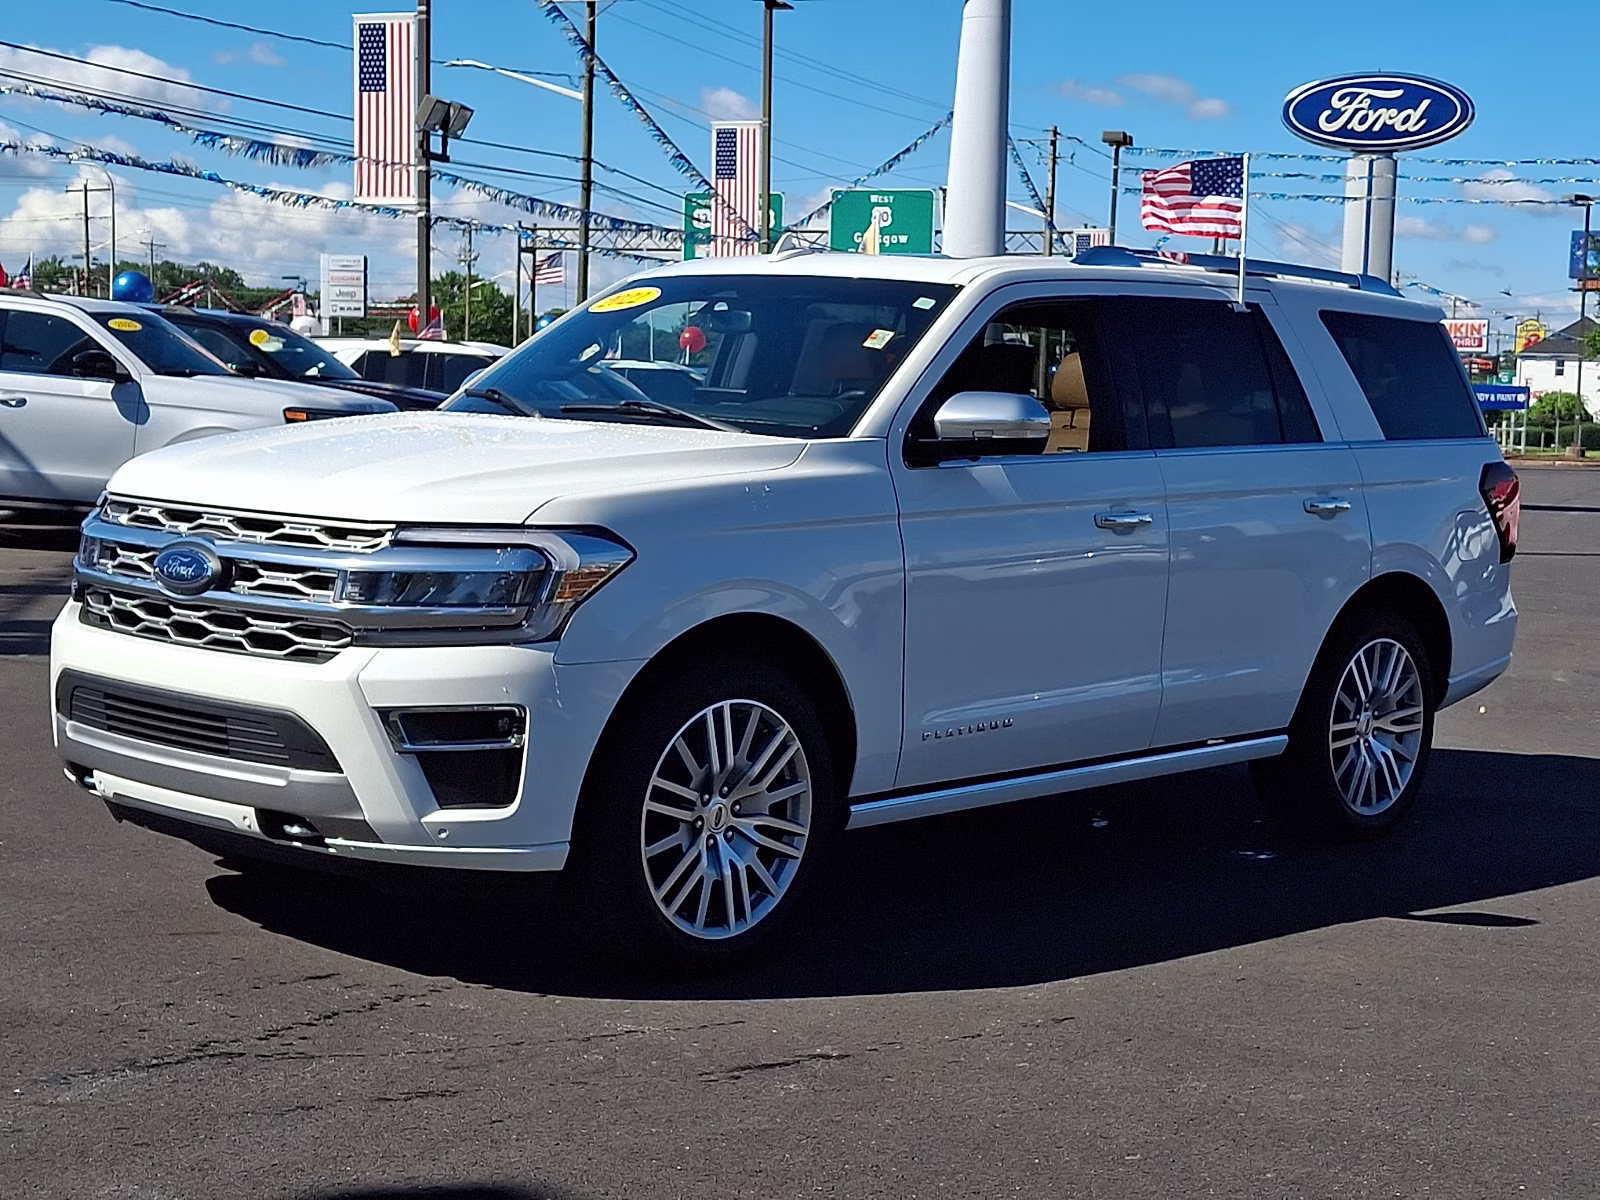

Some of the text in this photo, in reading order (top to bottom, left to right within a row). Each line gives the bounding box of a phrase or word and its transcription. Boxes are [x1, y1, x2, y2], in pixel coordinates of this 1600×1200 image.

[1318, 87, 1432, 133] Ford
[869, 194, 894, 203] WEST
[335, 288, 356, 299] Jeep
[163, 555, 197, 579] Ford
[922, 718, 1014, 742] PLATINUM
